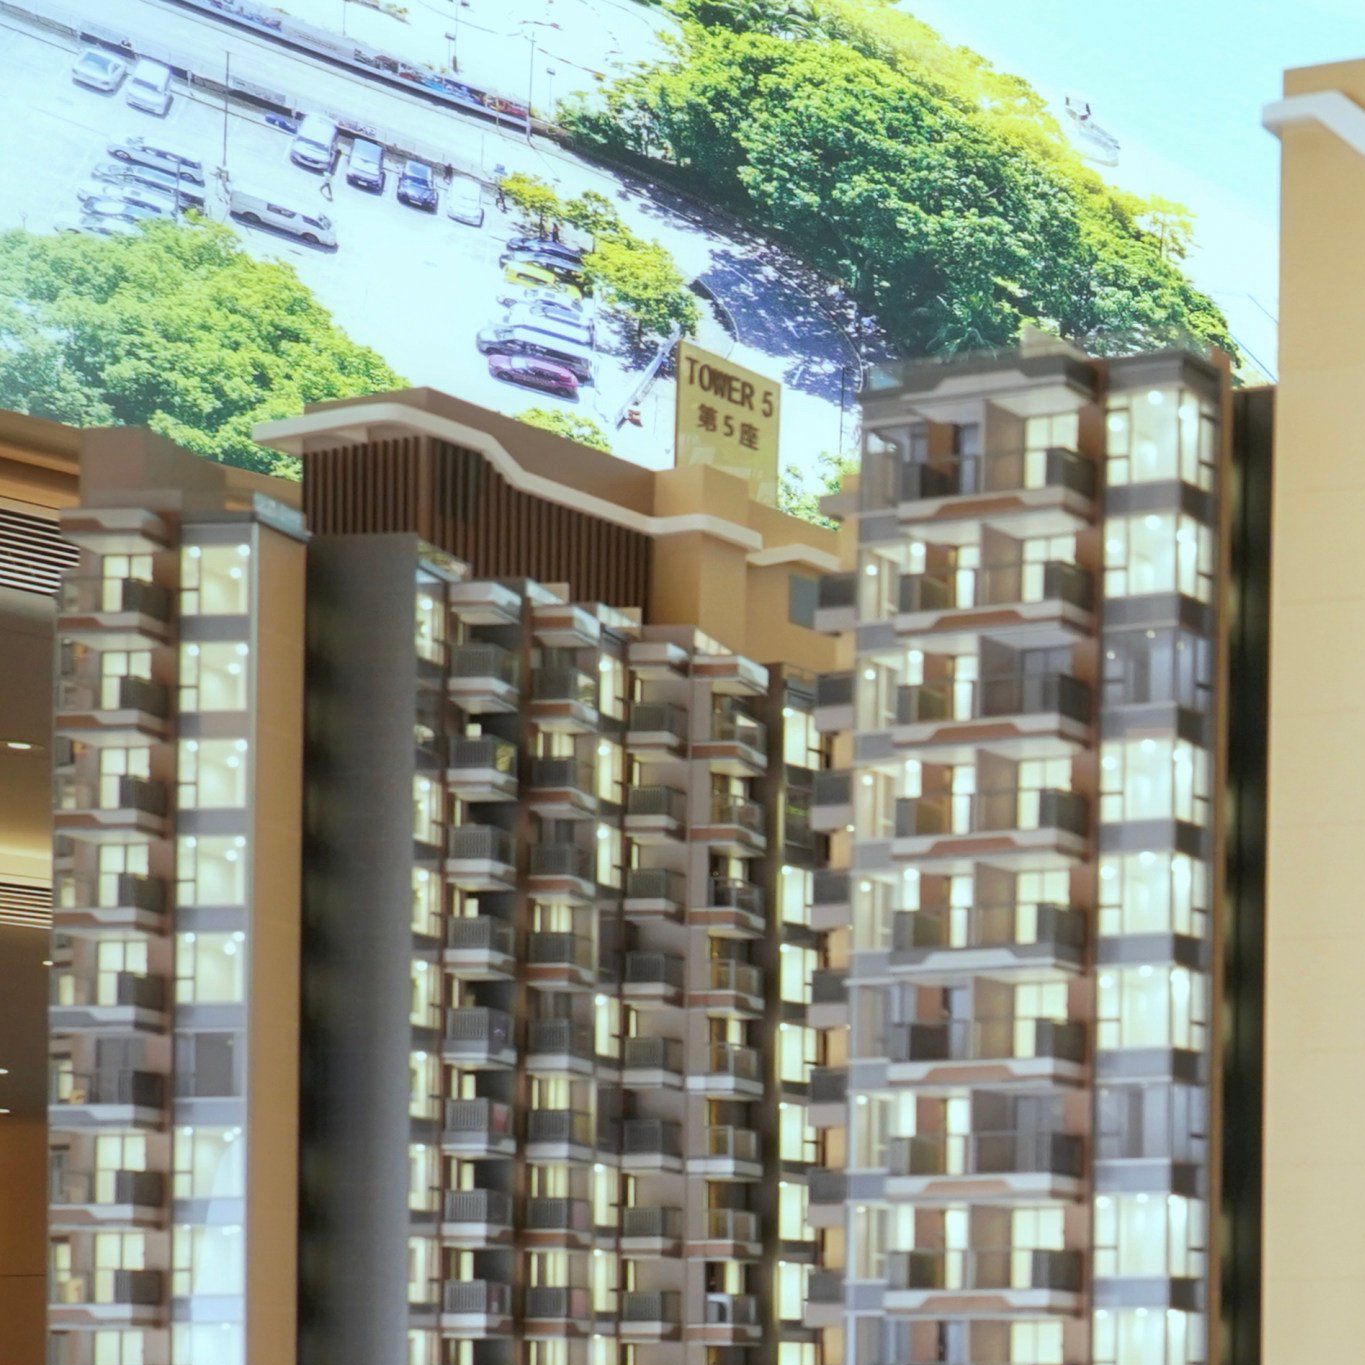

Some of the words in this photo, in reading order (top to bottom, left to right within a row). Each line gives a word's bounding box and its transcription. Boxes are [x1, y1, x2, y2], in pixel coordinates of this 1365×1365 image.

[684, 356, 755, 411] TOWER
[761, 390, 774, 418] 5
[696, 403, 760, 451] 第5座
